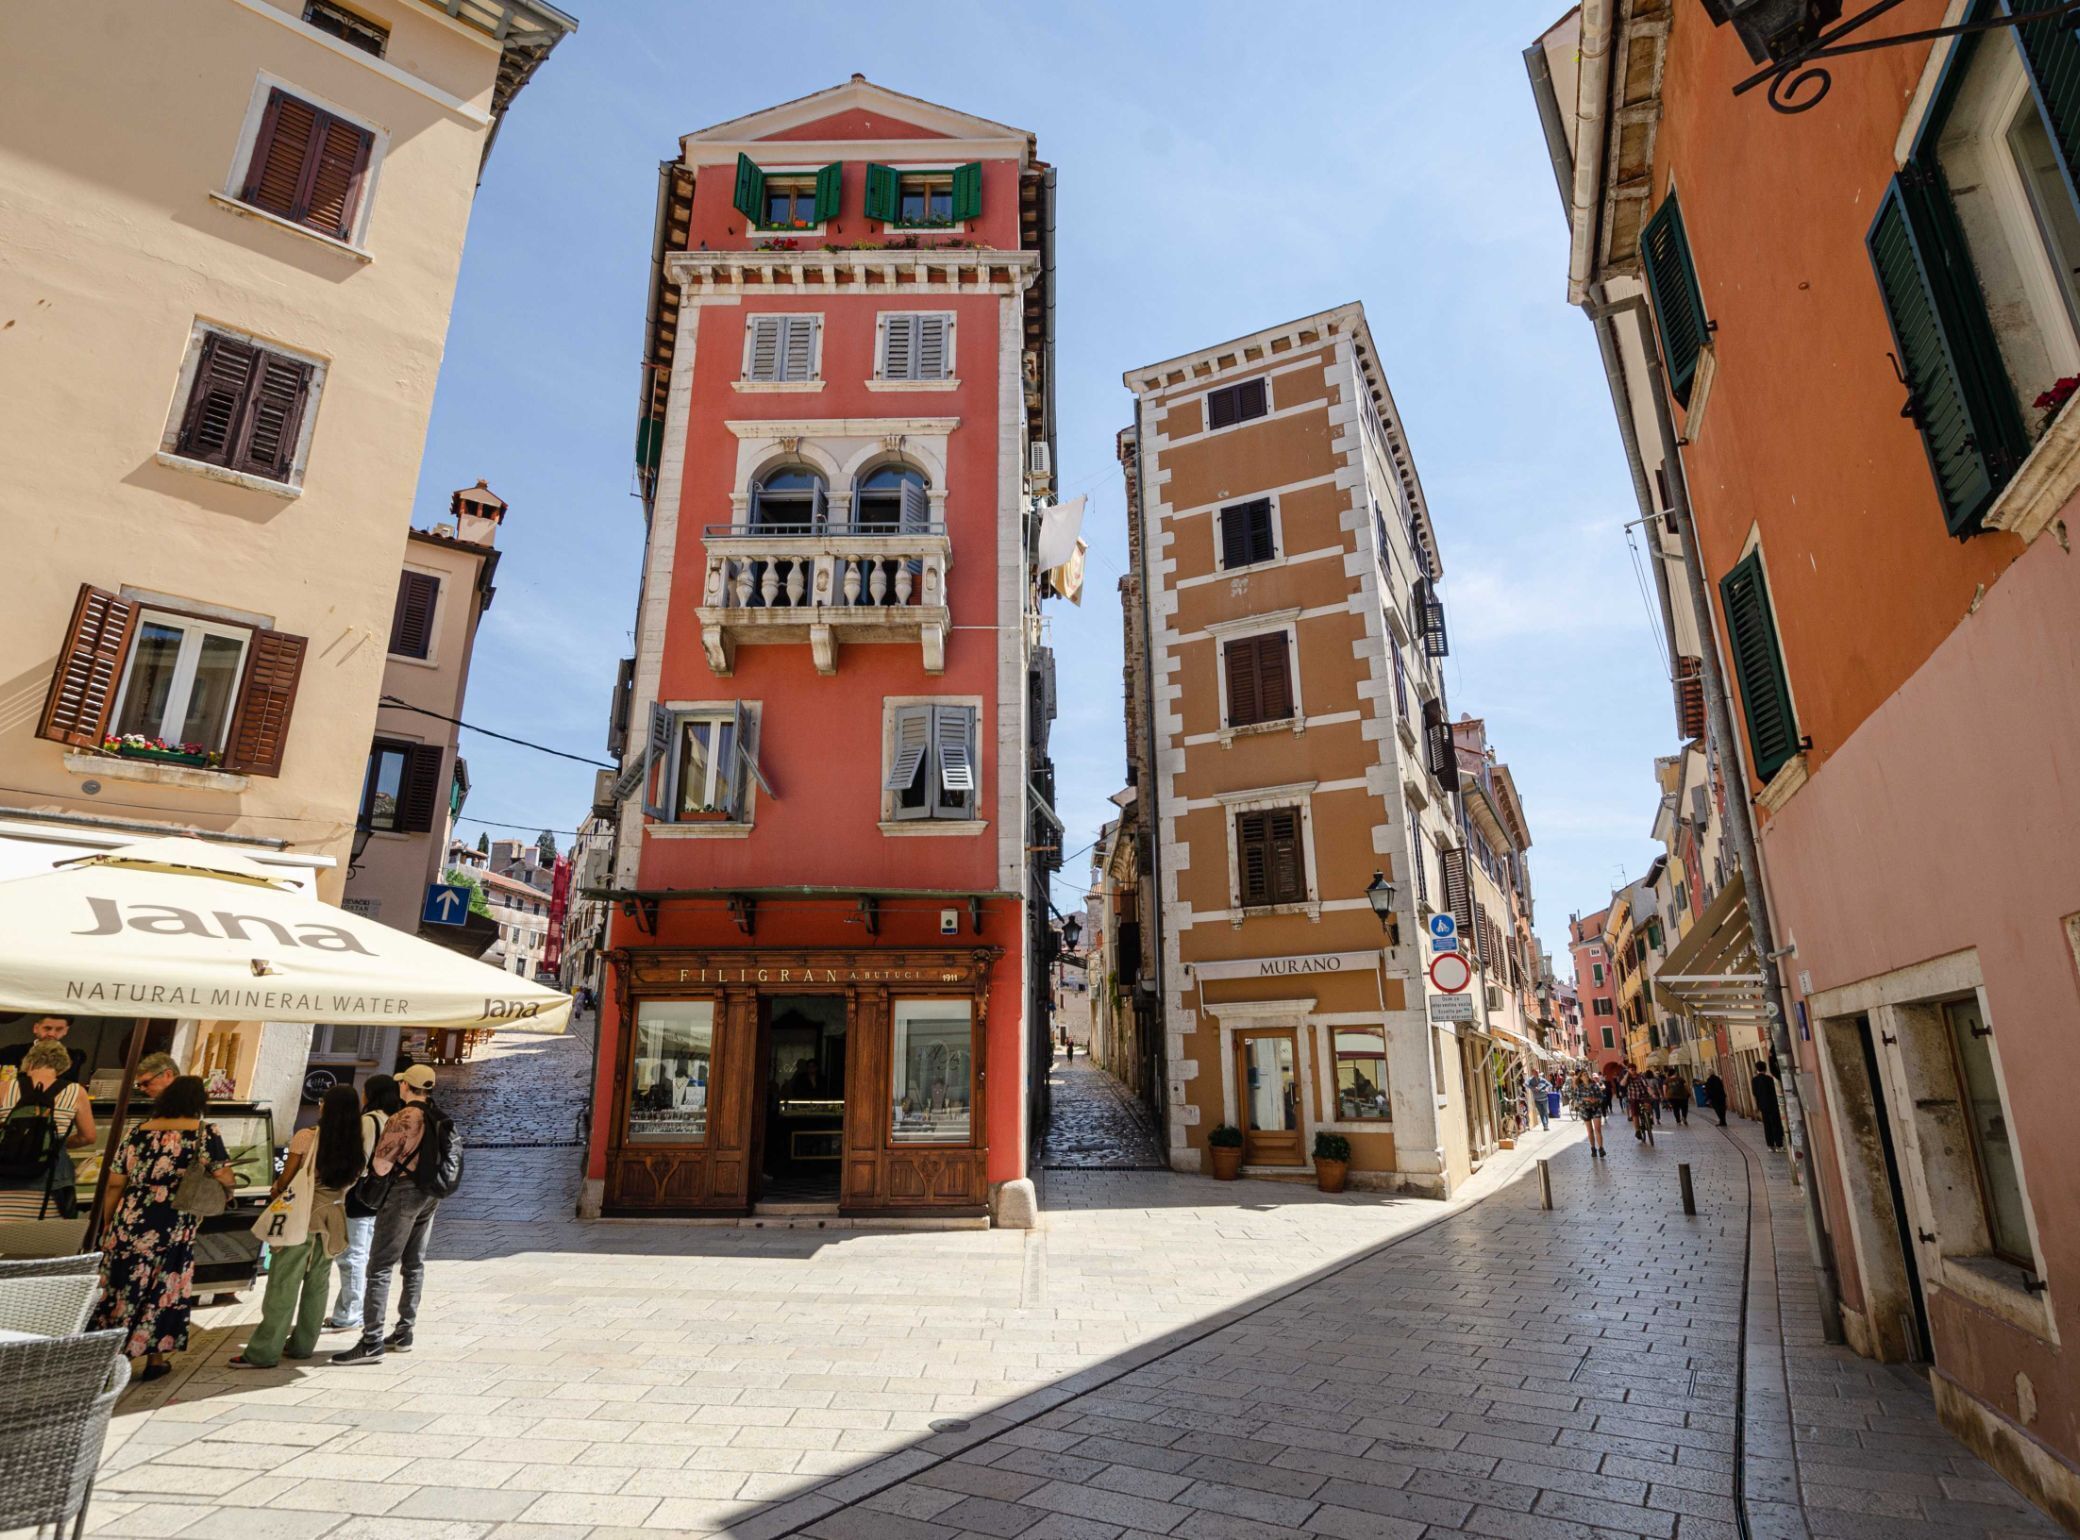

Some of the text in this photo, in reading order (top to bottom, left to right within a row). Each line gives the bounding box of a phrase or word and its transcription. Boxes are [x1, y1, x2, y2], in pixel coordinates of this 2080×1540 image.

[70, 896, 379, 956] Jana
[679, 968, 837, 983] FILIGRAN
[942, 973, 958, 982] 1911
[1260, 956, 1341, 975] MURANO
[66, 981, 409, 1015] NATURAL MINERAL WATER
[476, 998, 539, 1021] Jana
[267, 1213, 287, 1237] R
